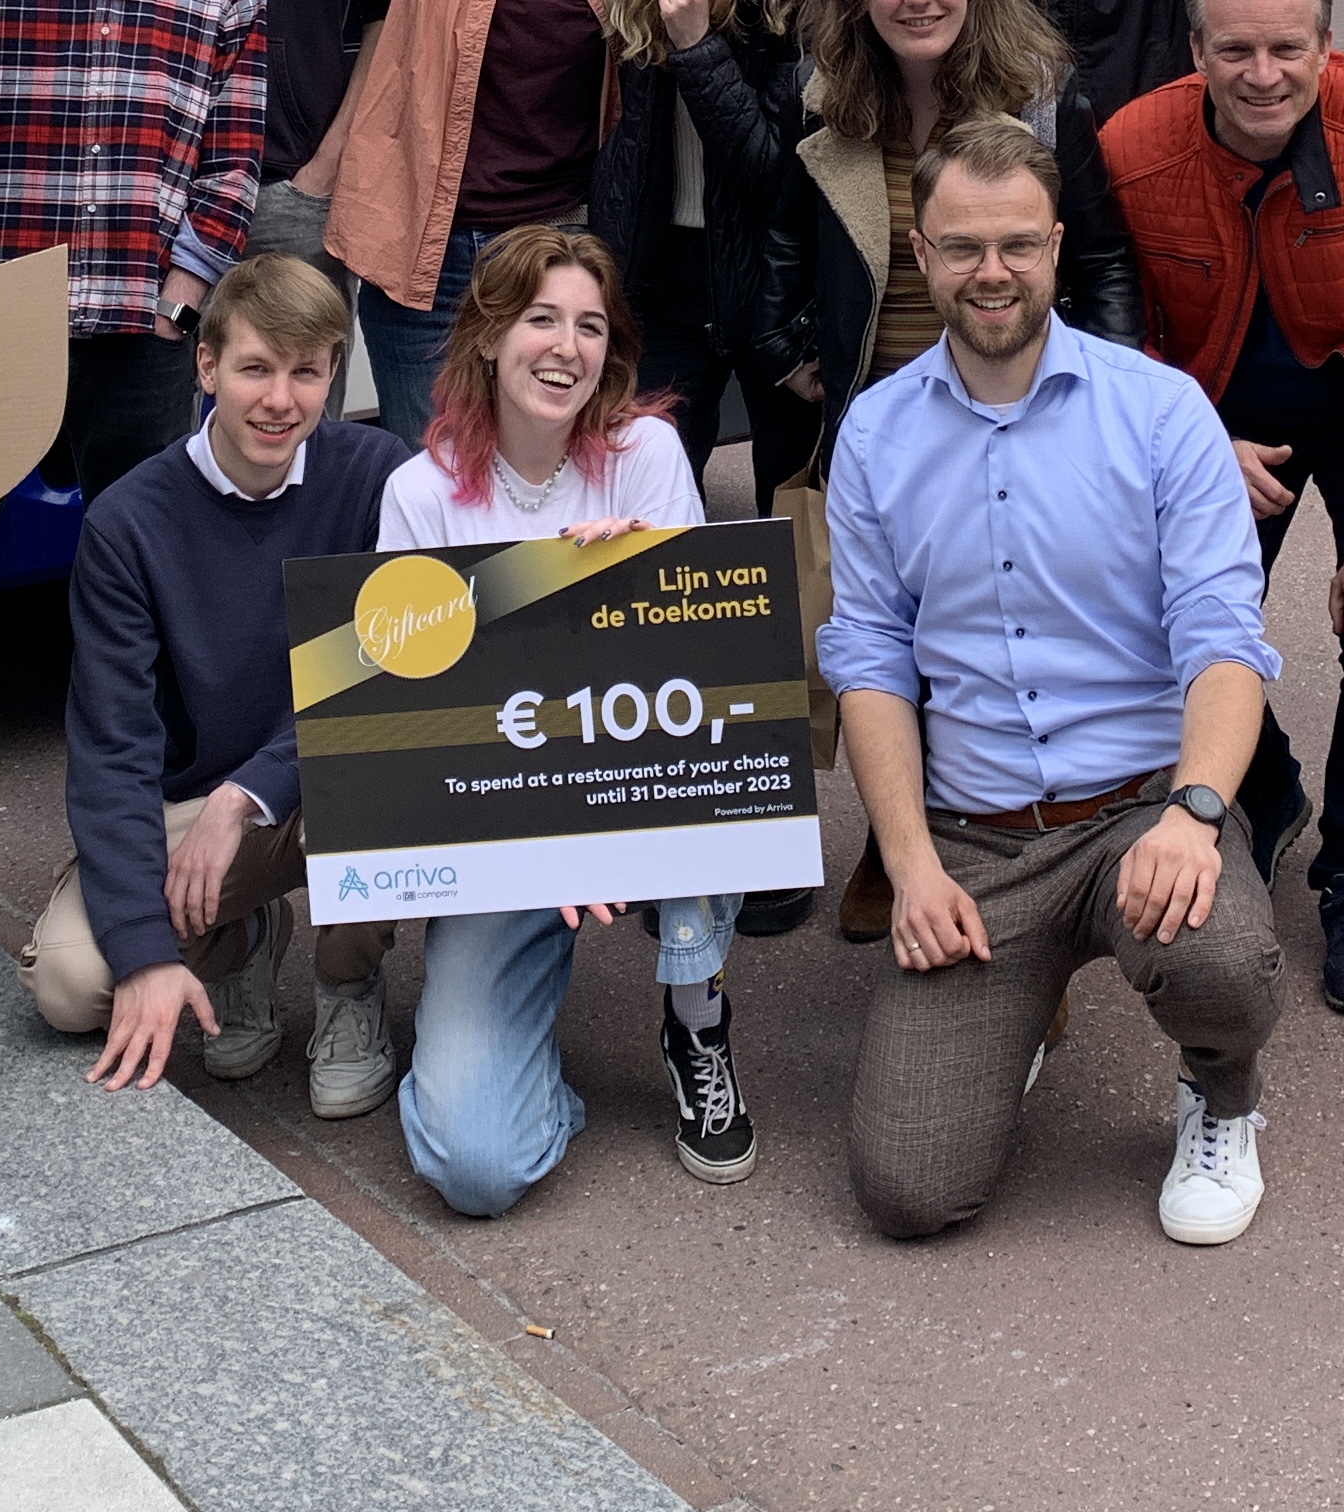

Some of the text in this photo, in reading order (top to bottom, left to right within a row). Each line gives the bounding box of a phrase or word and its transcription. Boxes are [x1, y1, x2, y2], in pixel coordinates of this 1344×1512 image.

[658, 565, 767, 595] Lijn van
[355, 575, 479, 667] Giftcard
[591, 594, 771, 629] de Toekomst
[496, 678, 754, 749] € 100,-
[445, 753, 789, 795] To spend at a restaurant of your choice
[586, 774, 791, 805] until 31 December 2023
[714, 802, 793, 817] Powered by Arriva
[374, 863, 457, 890] arriva
[417, 890, 458, 899] company
